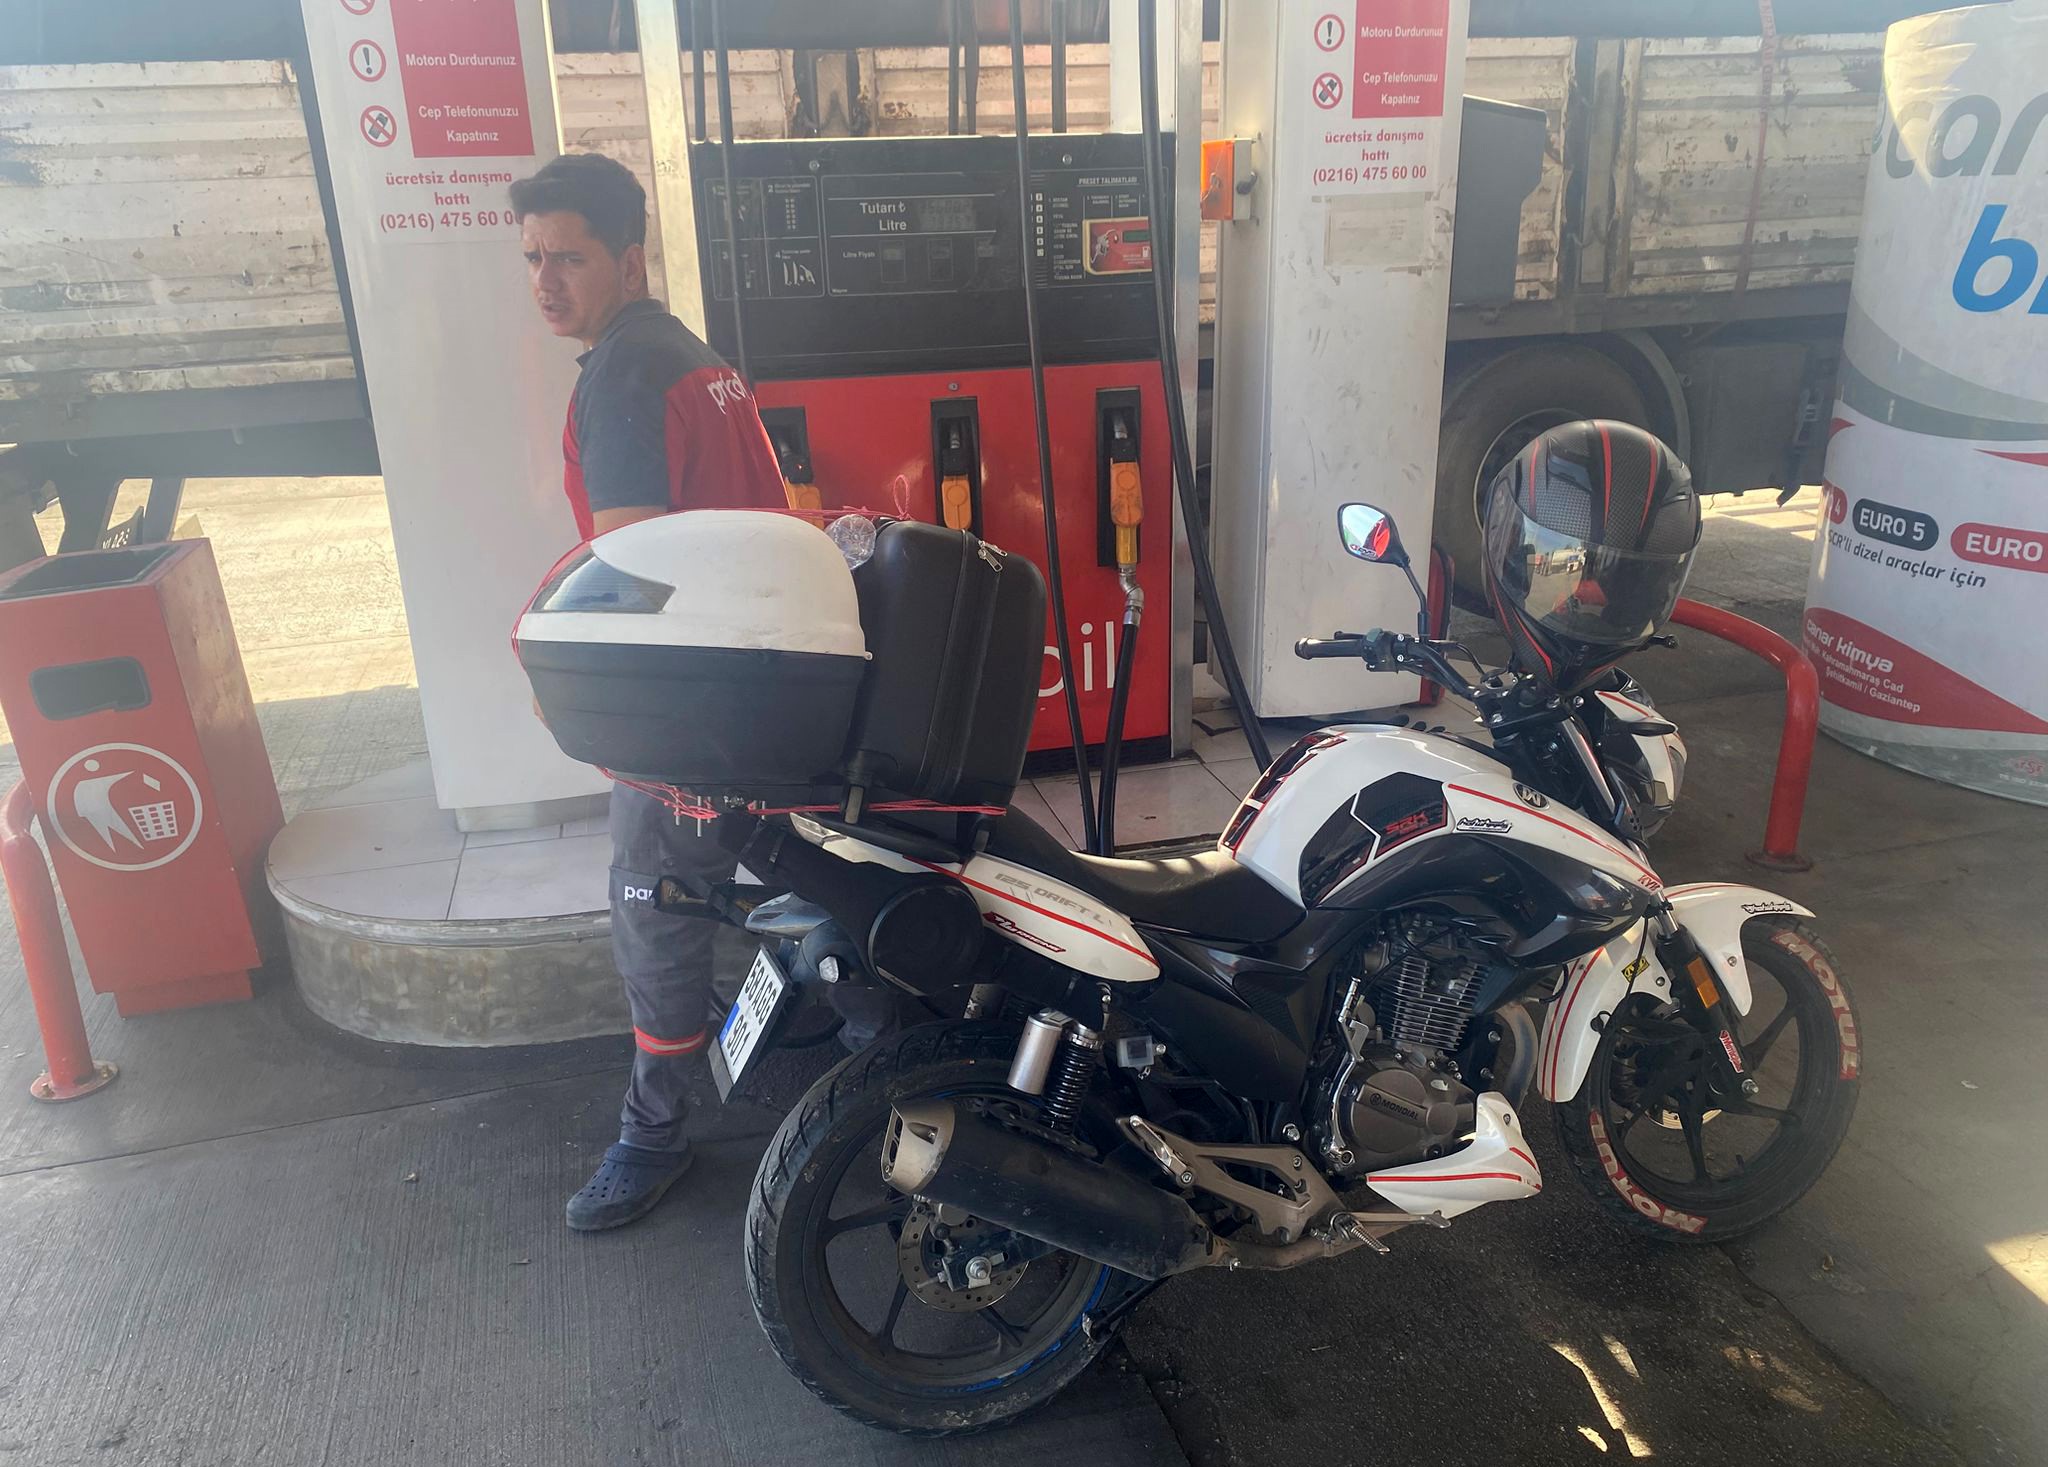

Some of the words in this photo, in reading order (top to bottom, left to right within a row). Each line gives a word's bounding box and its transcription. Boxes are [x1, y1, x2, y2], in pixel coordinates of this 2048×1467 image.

[1361, 26, 1393, 38] Motoru
[1394, 25, 1444, 37] Durdurunuz
[405, 53, 447, 67] Motoru
[449, 52, 517, 66] Durdurunuz
[1363, 72, 1380, 85] Cep
[1383, 71, 1439, 83] Telefonunuzu
[1380, 93, 1420, 107] Kapatınız
[418, 105, 442, 120] Cep
[443, 104, 519, 118] Telefonunuzu
[446, 129, 500, 144] Kapatınız
[1325, 130, 1373, 143] ücretsiz
[1376, 128, 1424, 144] danışma
[1361, 149, 1389, 161] hattı
[385, 170, 445, 186] ücretsiz
[448, 169, 513, 187] danışma
[1313, 168, 1358, 186] (0216)
[1362, 167, 1388, 180] 475
[1392, 166, 1407, 179] 60
[1412, 165, 1427, 179] 00
[768, 184, 774, 193] 2
[434, 191, 470, 206] hattı
[859, 202, 896, 214] Tutarı
[380, 212, 435, 232] (0216)
[441, 211, 473, 228] 475
[477, 210, 498, 227] 60
[879, 219, 907, 231] Litre
[1859, 507, 1907, 536] EURO
[1912, 521, 1926, 542] 5
[1966, 531, 2044, 562] EURO
[1828, 529, 1852, 553] SCR'li
[1853, 541, 1883, 564] dizel
[1886, 556, 1946, 578] araçlar
[1950, 567, 1987, 589] için
[1836, 636, 1894, 673] kimya
[1883, 678, 1904, 693] Cad
[1869, 687, 1921, 713] Gaziantep
[995, 873, 1032, 890] 125
[1034, 887, 1090, 914] DRIFT
[727, 1013, 751, 1067] 901
[1381, 1099, 1419, 1120] MONDIAL
